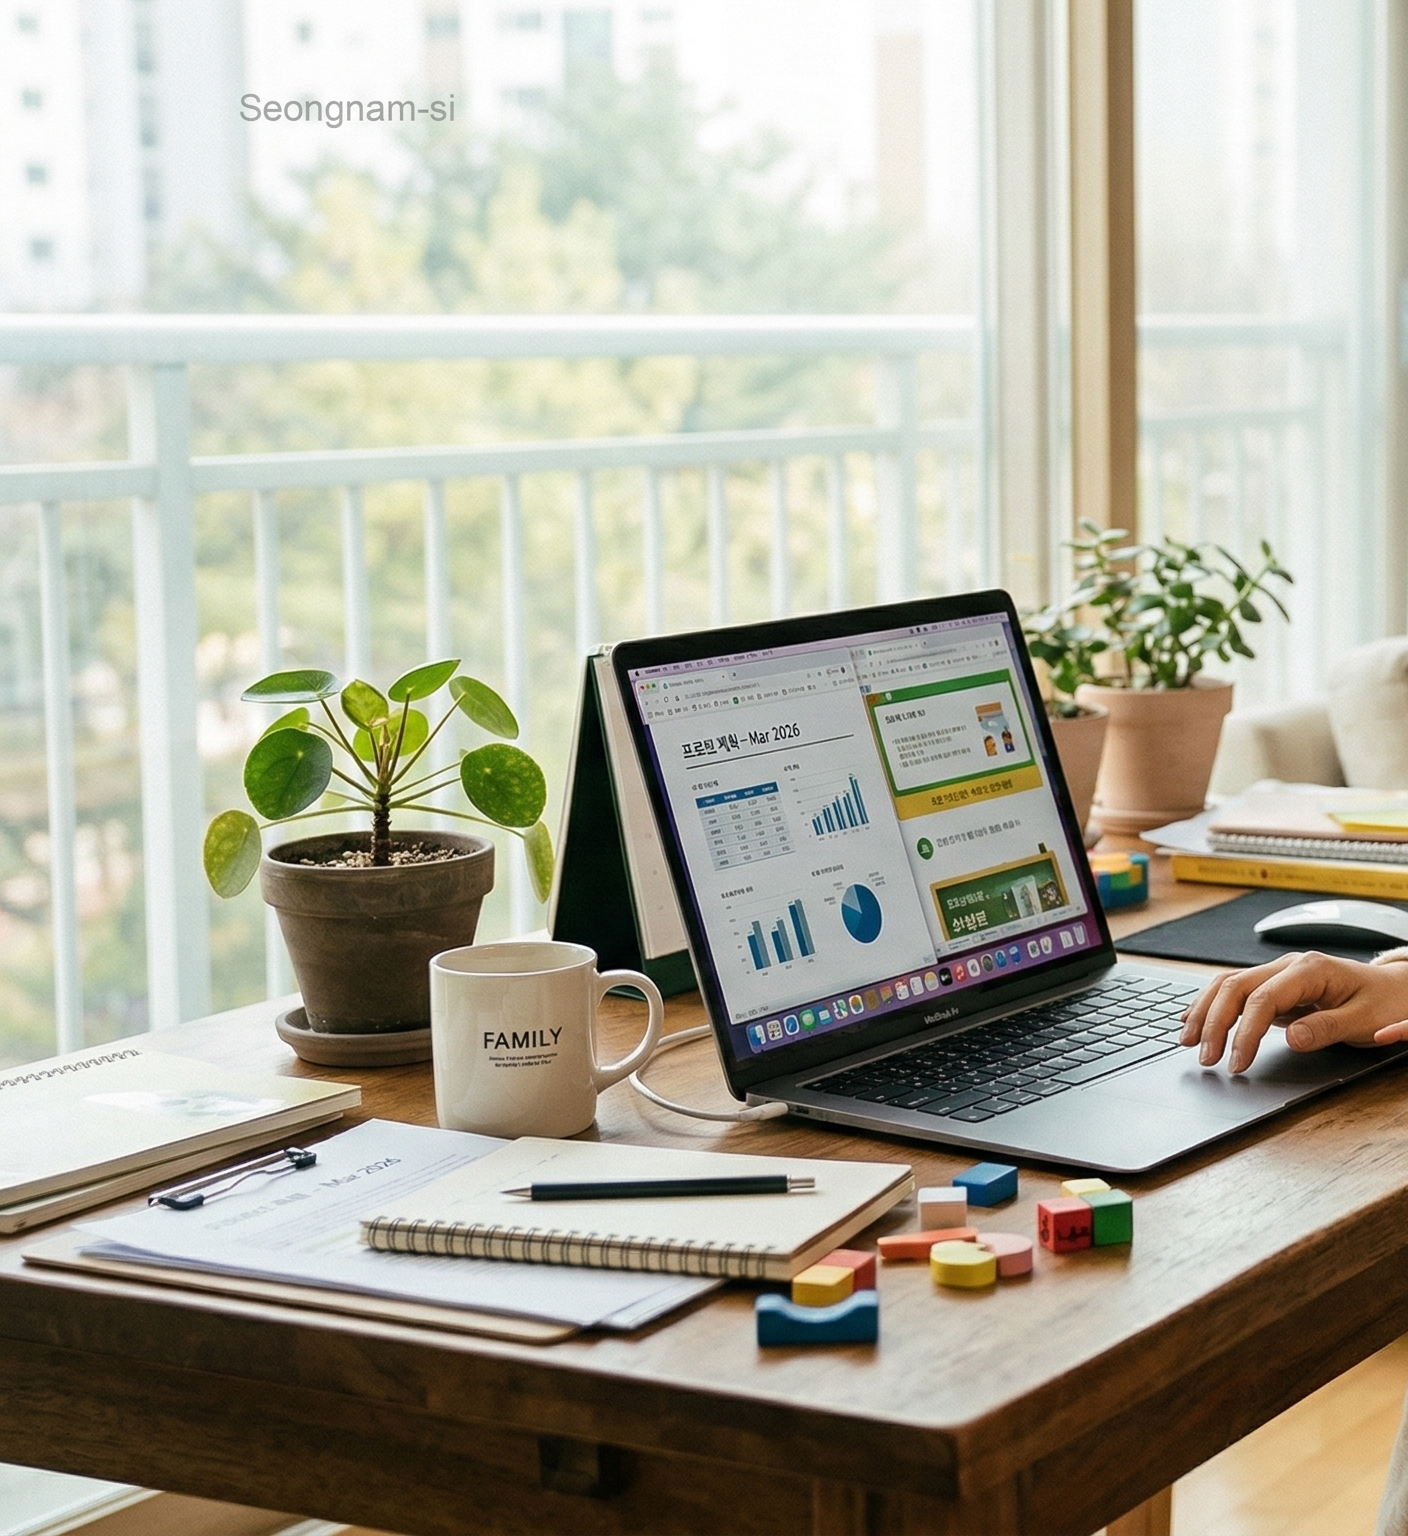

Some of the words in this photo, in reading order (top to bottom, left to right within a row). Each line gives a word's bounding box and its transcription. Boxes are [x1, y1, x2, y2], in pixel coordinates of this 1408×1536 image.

[749, 731, 770, 745] Mar
[772, 723, 800, 740] 2026
[483, 1026, 563, 1050] FAMILY
